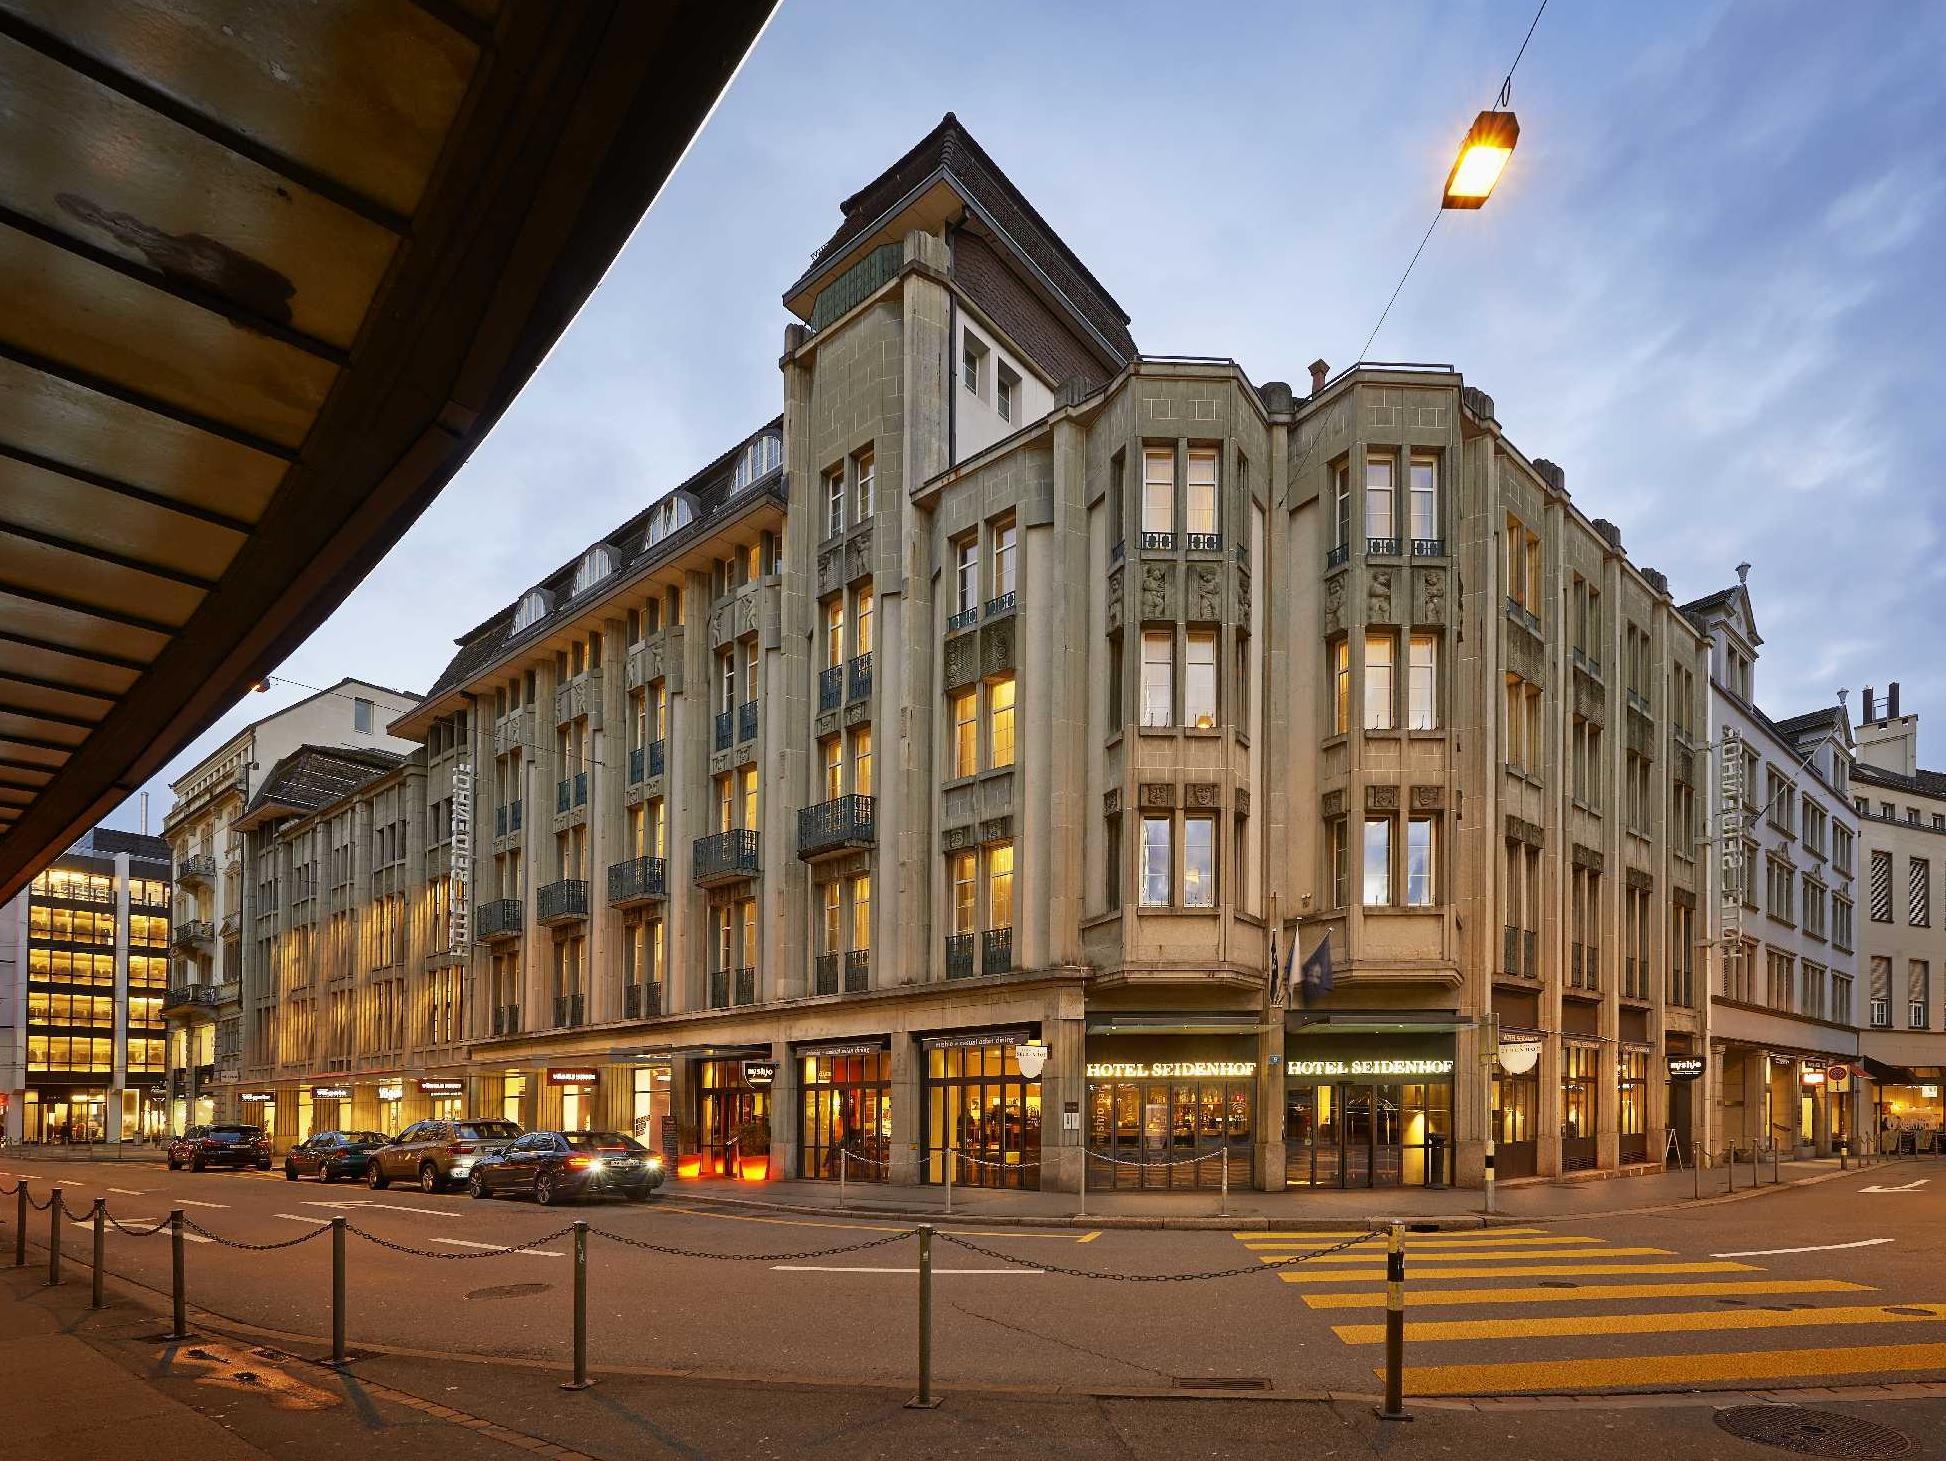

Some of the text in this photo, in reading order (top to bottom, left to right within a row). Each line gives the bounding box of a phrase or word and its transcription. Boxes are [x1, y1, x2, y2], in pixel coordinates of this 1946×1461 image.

[1086, 1062, 1257, 1077] HOTEL SEIDENHOF
[1287, 1060, 1454, 1075] HOTEL SEIDENHOF
